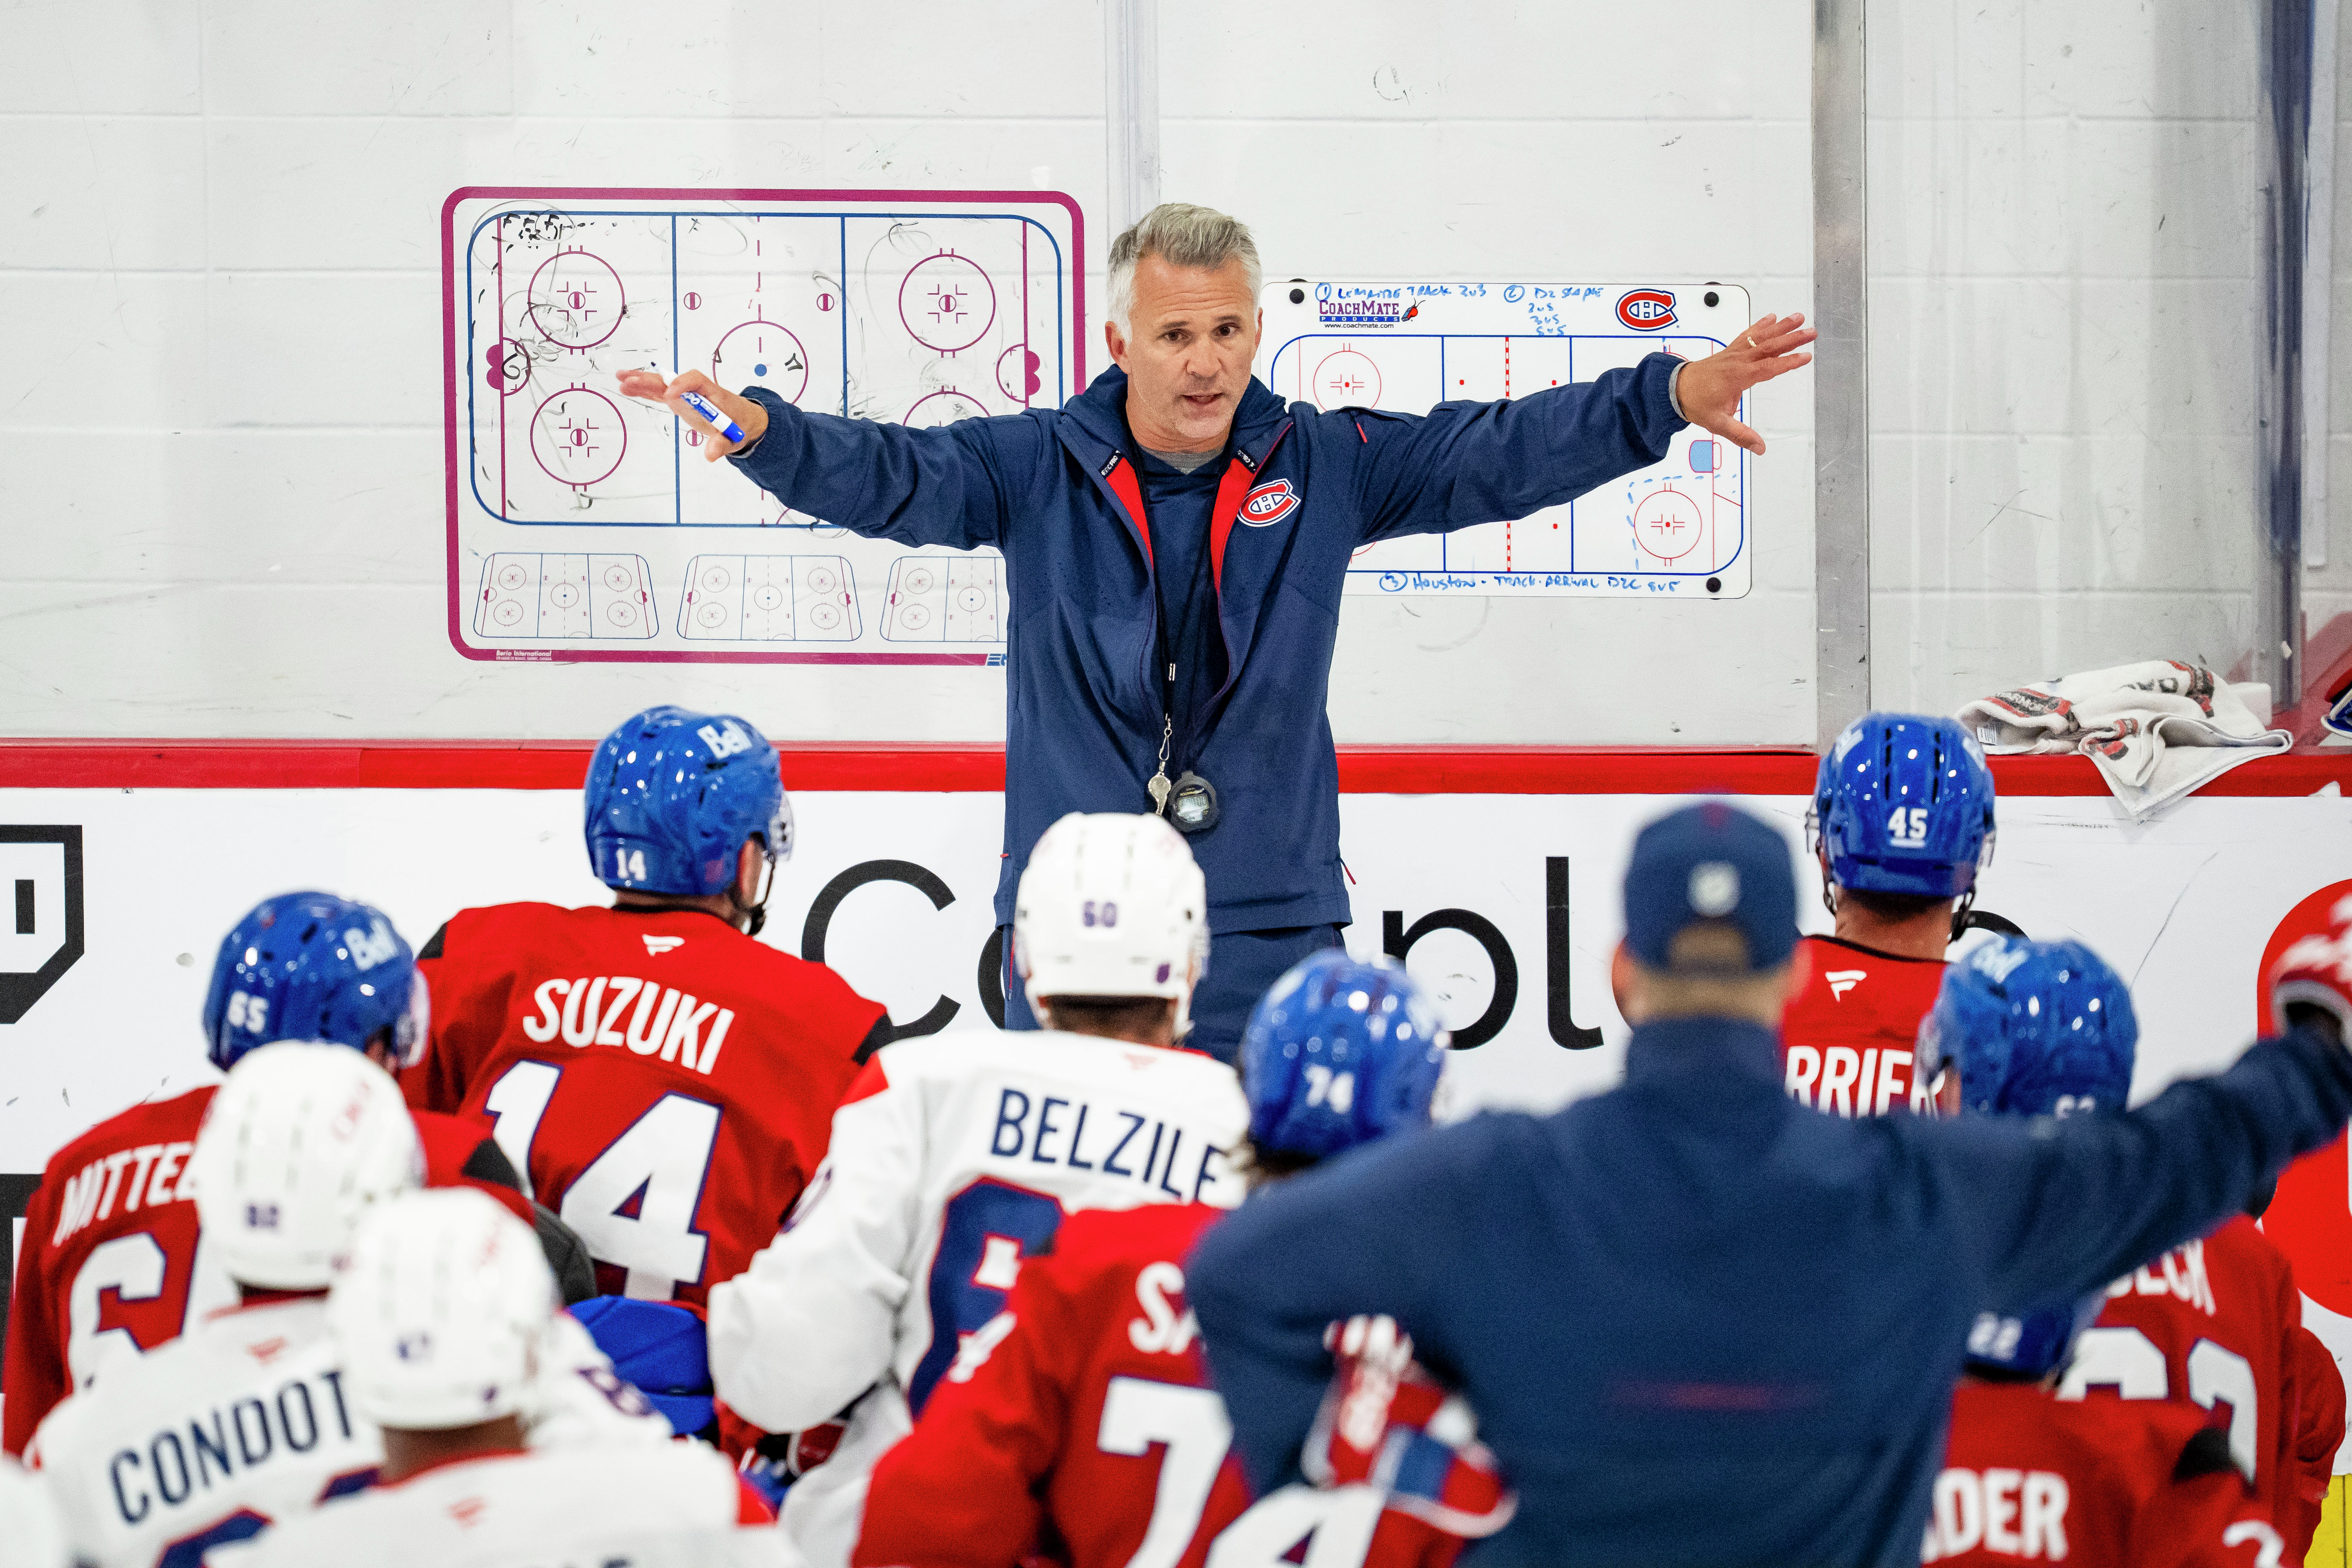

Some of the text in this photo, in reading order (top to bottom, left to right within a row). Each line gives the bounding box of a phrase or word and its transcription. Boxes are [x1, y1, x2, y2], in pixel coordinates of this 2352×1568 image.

[1887, 806, 1929, 839] 45
[616, 847, 647, 882] 14
[1082, 900, 1119, 928] 60
[227, 989, 271, 1034] 65
[522, 976, 736, 1076] SUZUKI
[482, 1058, 724, 1301] 14
